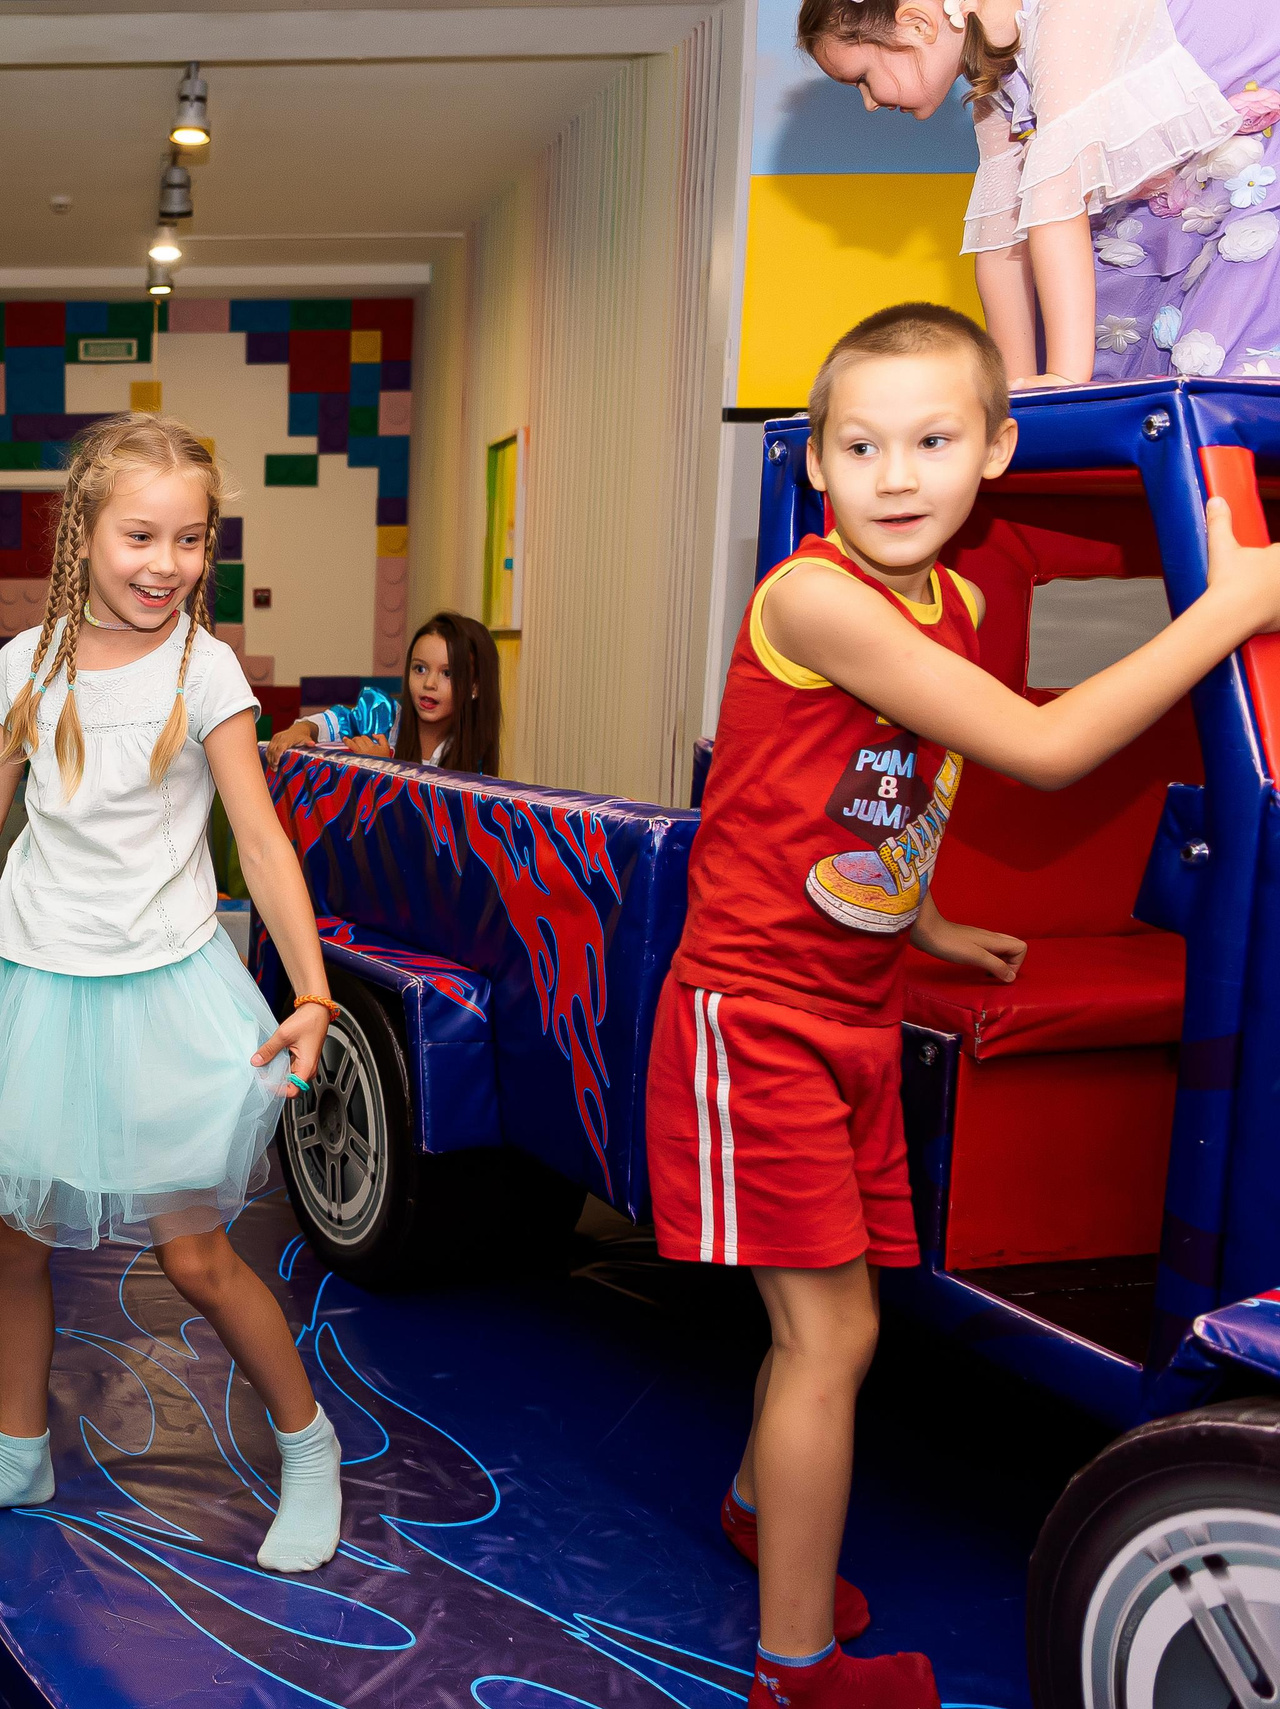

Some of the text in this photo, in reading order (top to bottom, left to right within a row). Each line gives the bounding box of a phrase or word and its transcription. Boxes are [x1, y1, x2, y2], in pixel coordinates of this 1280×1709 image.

[855, 749, 918, 778] PUM
[877, 775, 899, 799] &
[842, 798, 911, 830] JUMP
